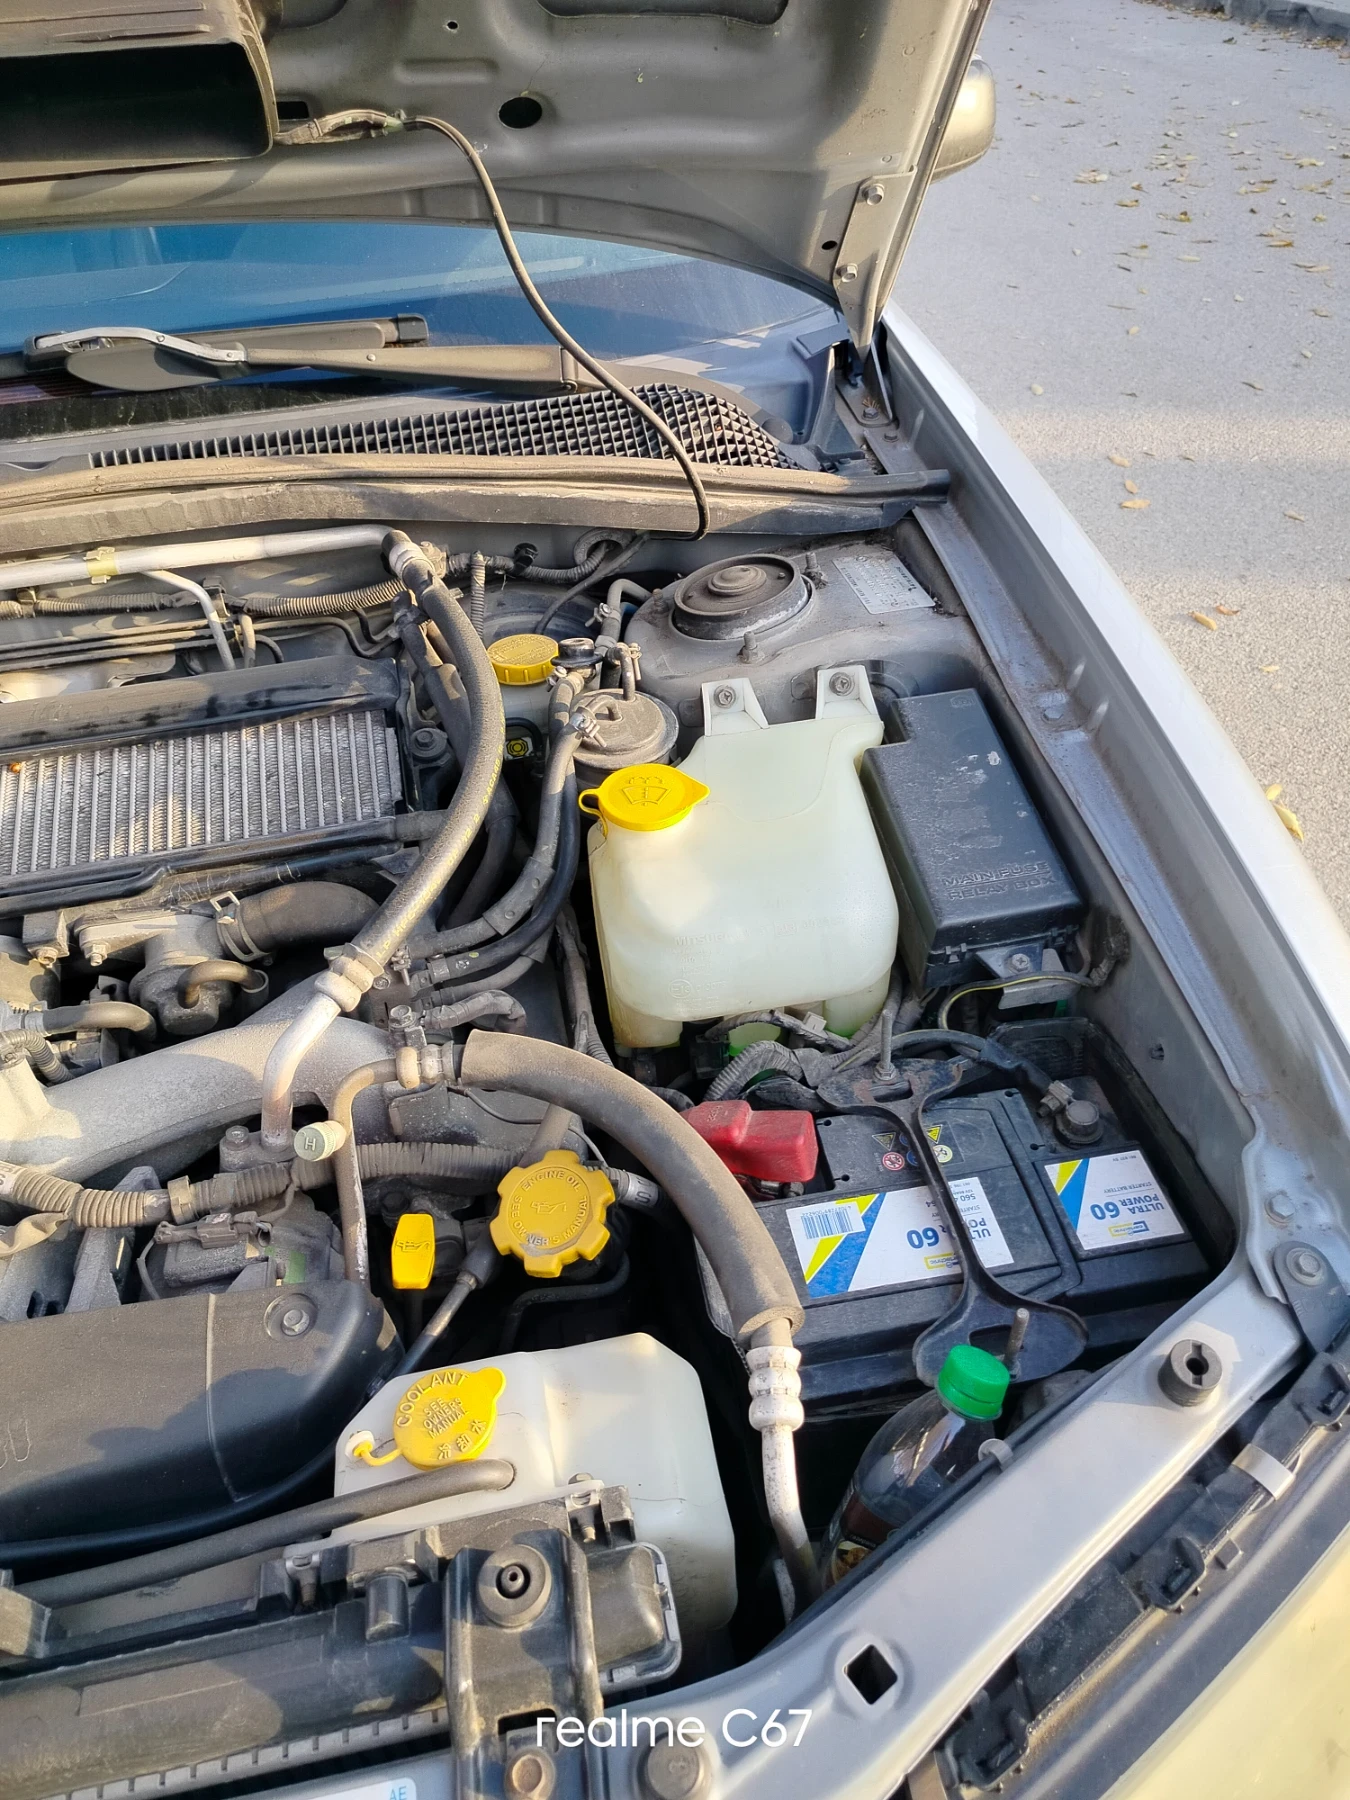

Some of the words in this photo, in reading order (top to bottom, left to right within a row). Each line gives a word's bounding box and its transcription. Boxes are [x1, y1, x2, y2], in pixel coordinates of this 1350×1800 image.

[942, 870, 995, 886] MAIN
[998, 860, 1051, 877] FUSE
[949, 884, 1009, 901] RELAY
[1013, 875, 1057, 890] BOX
[304, 1136, 316, 1151] H
[521, 1170, 565, 1192] ENGINE
[566, 1175, 582, 1192] OIL
[1103, 1185, 1128, 1194] BATTERY
[1128, 1181, 1152, 1190] STARTER
[511, 1195, 523, 1218] SEE
[1089, 1201, 1120, 1220] 60
[1119, 1193, 1160, 1207] POWER
[1127, 1202, 1165, 1215] ULTRA
[563, 1195, 588, 1240] MANUAL
[513, 1220, 561, 1246] OWNER'S
[906, 1226, 940, 1249] 60
[396, 1371, 470, 1428] COOLANT
[423, 1397, 446, 1416] SEE
[423, 1397, 463, 1430] OWNERS
[428, 1408, 469, 1439] MANUAL
